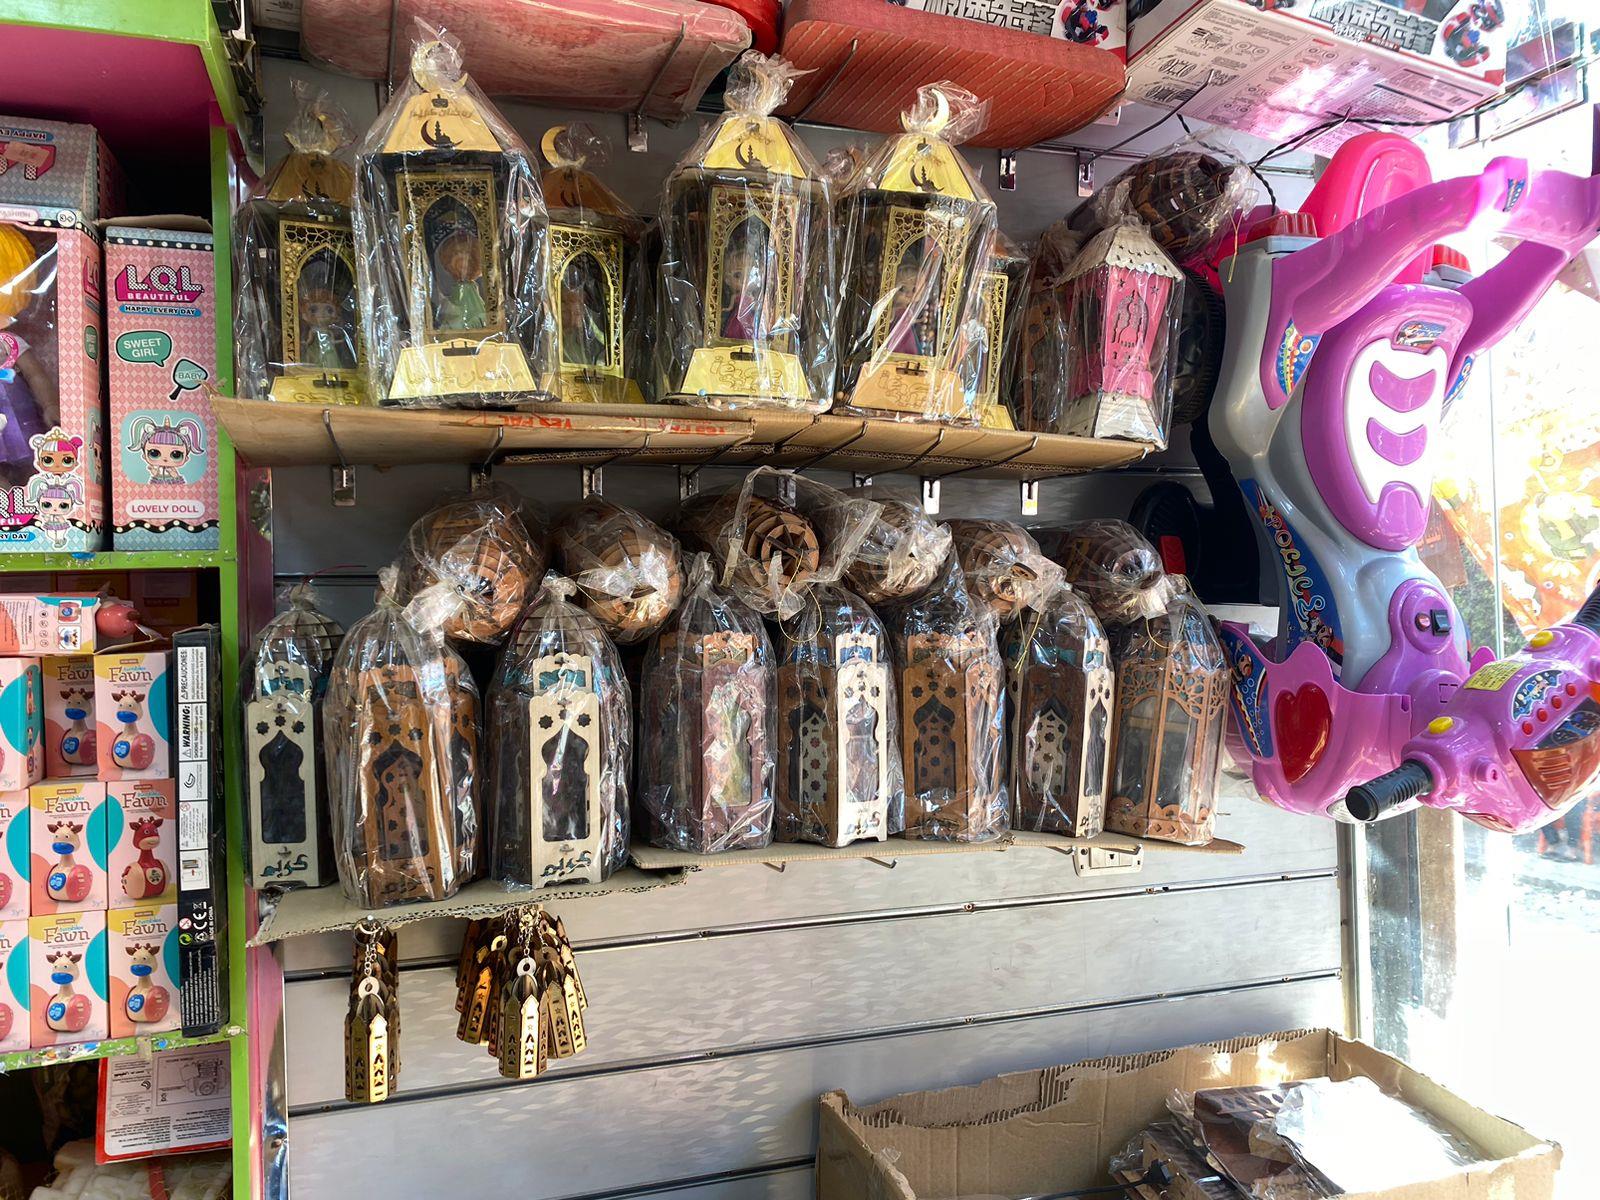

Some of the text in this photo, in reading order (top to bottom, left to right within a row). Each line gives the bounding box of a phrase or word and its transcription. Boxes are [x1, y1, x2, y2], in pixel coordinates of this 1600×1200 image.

[127, 292, 190, 301] BEAUTIFUL
[125, 305, 196, 315] HAPPY EVERY DAY
[123, 337, 162, 349] SWEET
[131, 347, 159, 358] GIRL
[178, 371, 202, 380] BABY
[131, 504, 199, 513] LOVELY DOLL
[109, 667, 153, 682] Fawn
[182, 705, 191, 748] WARNING:
[44, 797, 92, 814] Fawn
[122, 792, 167, 808] Fawn
[260, 854, 309, 879] كريم
[43, 927, 91, 944] Fawn
[122, 920, 169, 936] Fawn
